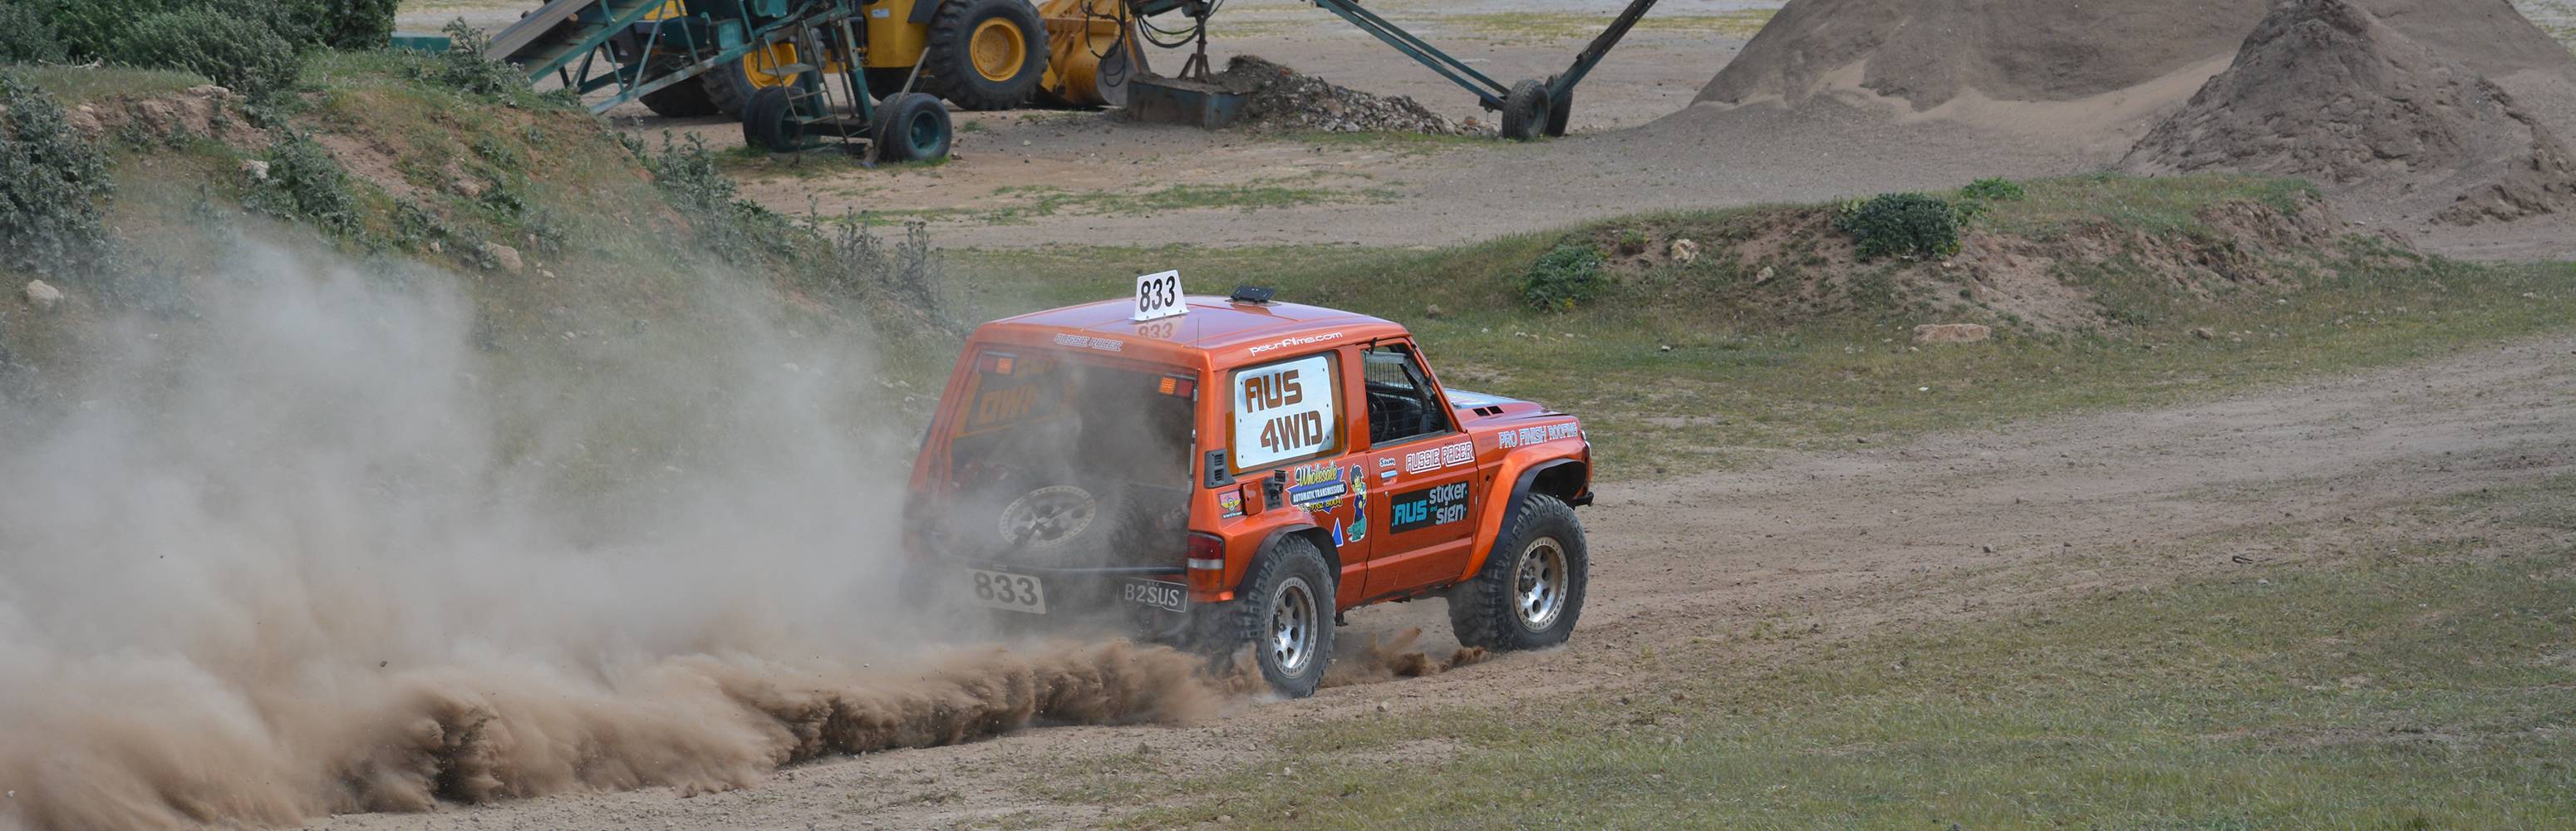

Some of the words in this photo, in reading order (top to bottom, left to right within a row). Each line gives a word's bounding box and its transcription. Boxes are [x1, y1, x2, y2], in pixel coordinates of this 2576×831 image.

[1139, 276, 1176, 312] 833
[1244, 369, 1303, 413] AUS
[1260, 410, 1323, 453] 4WD
[1498, 430, 1517, 449] PRO
[1519, 425, 1547, 445] FINISH
[1547, 422, 1579, 440] ROOFING
[1406, 448, 1441, 475] AUSSIE
[1442, 442, 1475, 468] RACER
[1295, 461, 1338, 487] Wholesale
[1293, 489, 1315, 503] AUTOMATIC
[1315, 484, 1345, 499] TRANSMISSIONS
[1429, 483, 1467, 506] sticker
[1394, 499, 1428, 525] AUS
[1436, 504, 1463, 525] sign
[973, 571, 1038, 607] 833
[1124, 583, 1179, 607] B2SUS
